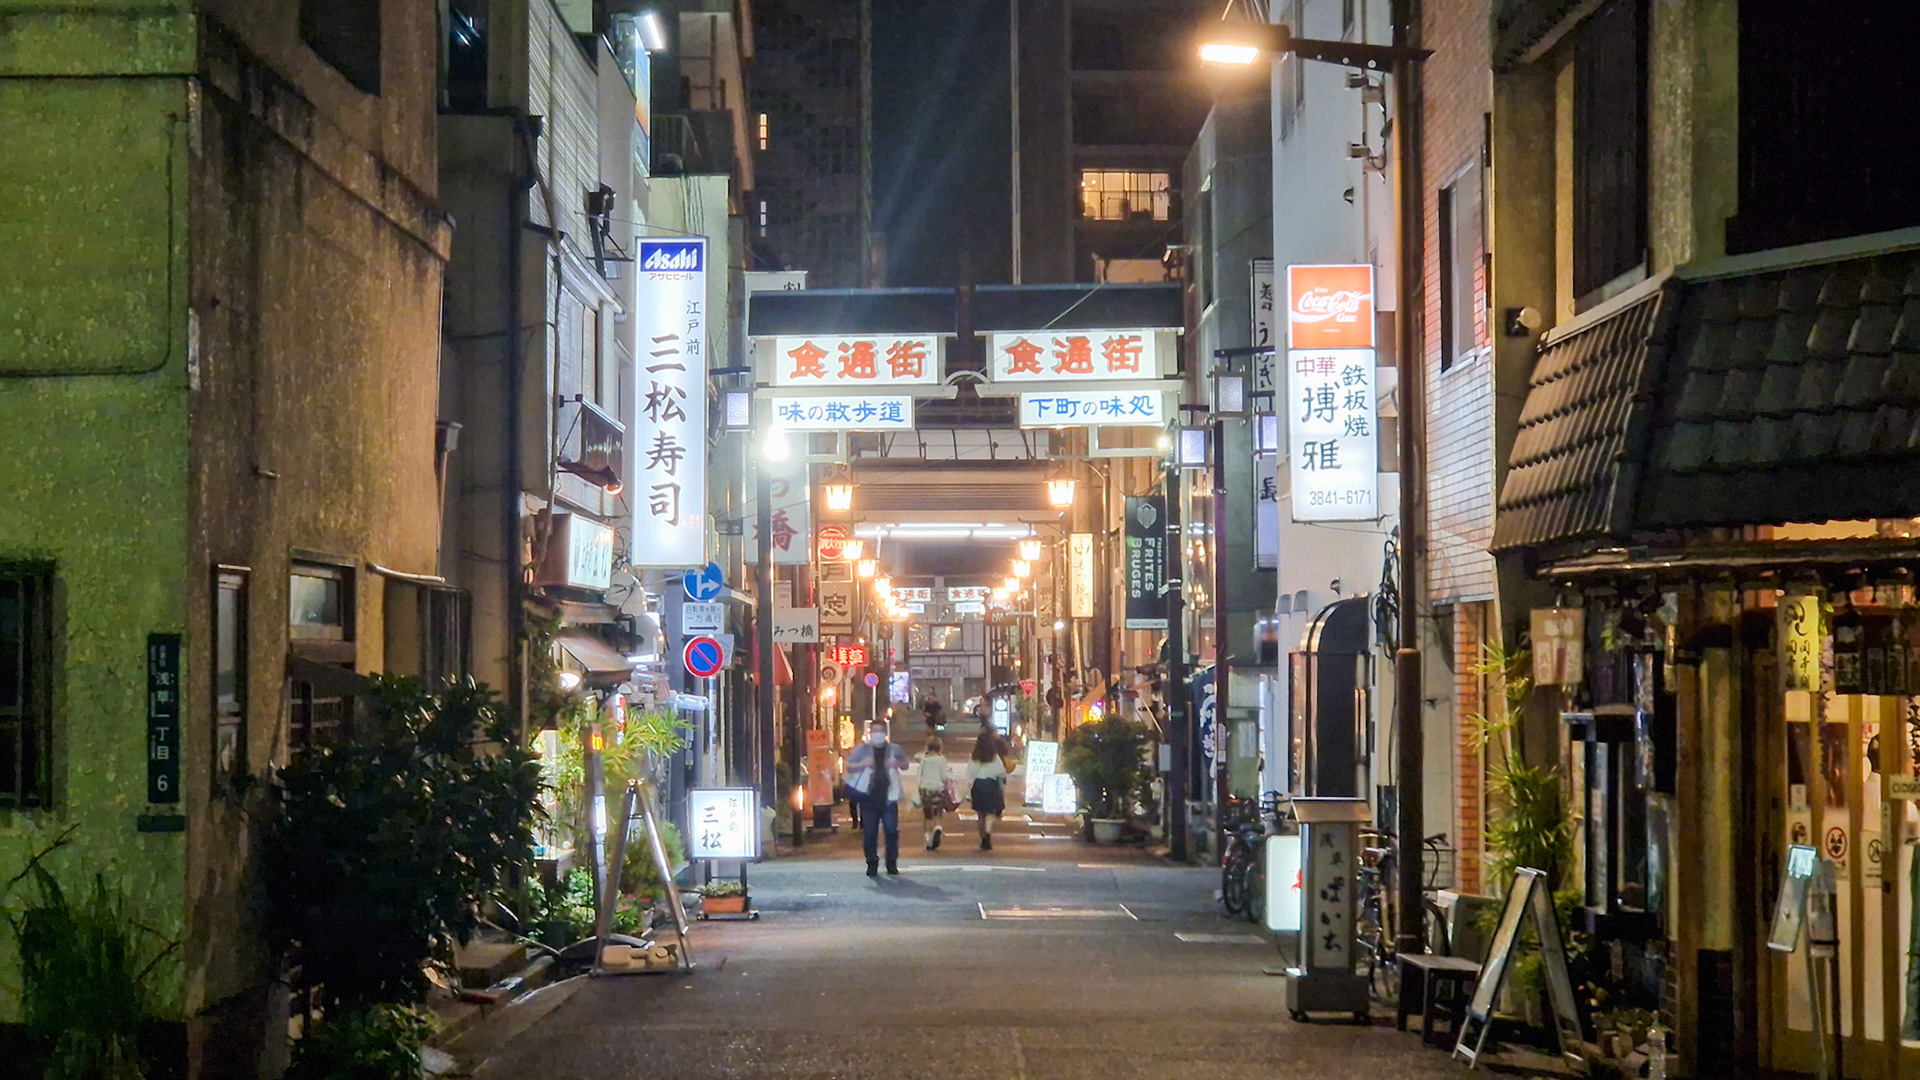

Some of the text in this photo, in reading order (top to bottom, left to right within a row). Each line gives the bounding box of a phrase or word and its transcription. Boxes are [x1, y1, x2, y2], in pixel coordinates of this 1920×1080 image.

[645, 248, 699, 270] Asahi
[648, 272, 694, 281] アサヒビール
[685, 300, 702, 356] 江戸前
[787, 340, 931, 380] 食通街
[1002, 336, 1143, 375] 食通街
[1295, 356, 1337, 378] 中華
[778, 401, 905, 424] 味の散歩道
[1028, 395, 1154, 418] 下町の味処
[1340, 364, 1370, 437] 鉄板焼
[641, 333, 687, 527] 三松寿司
[1309, 489, 1372, 506] 3841-6171
[1131, 537, 1143, 599] BRUGES
[1144, 537, 1156, 592] FRITES
[686, 614, 722, 623] 一方通行
[774, 624, 814, 639] みつ橋
[155, 671, 170, 760] 浅草一丁目
[157, 775, 168, 791] 6
[702, 806, 722, 851] 三松
